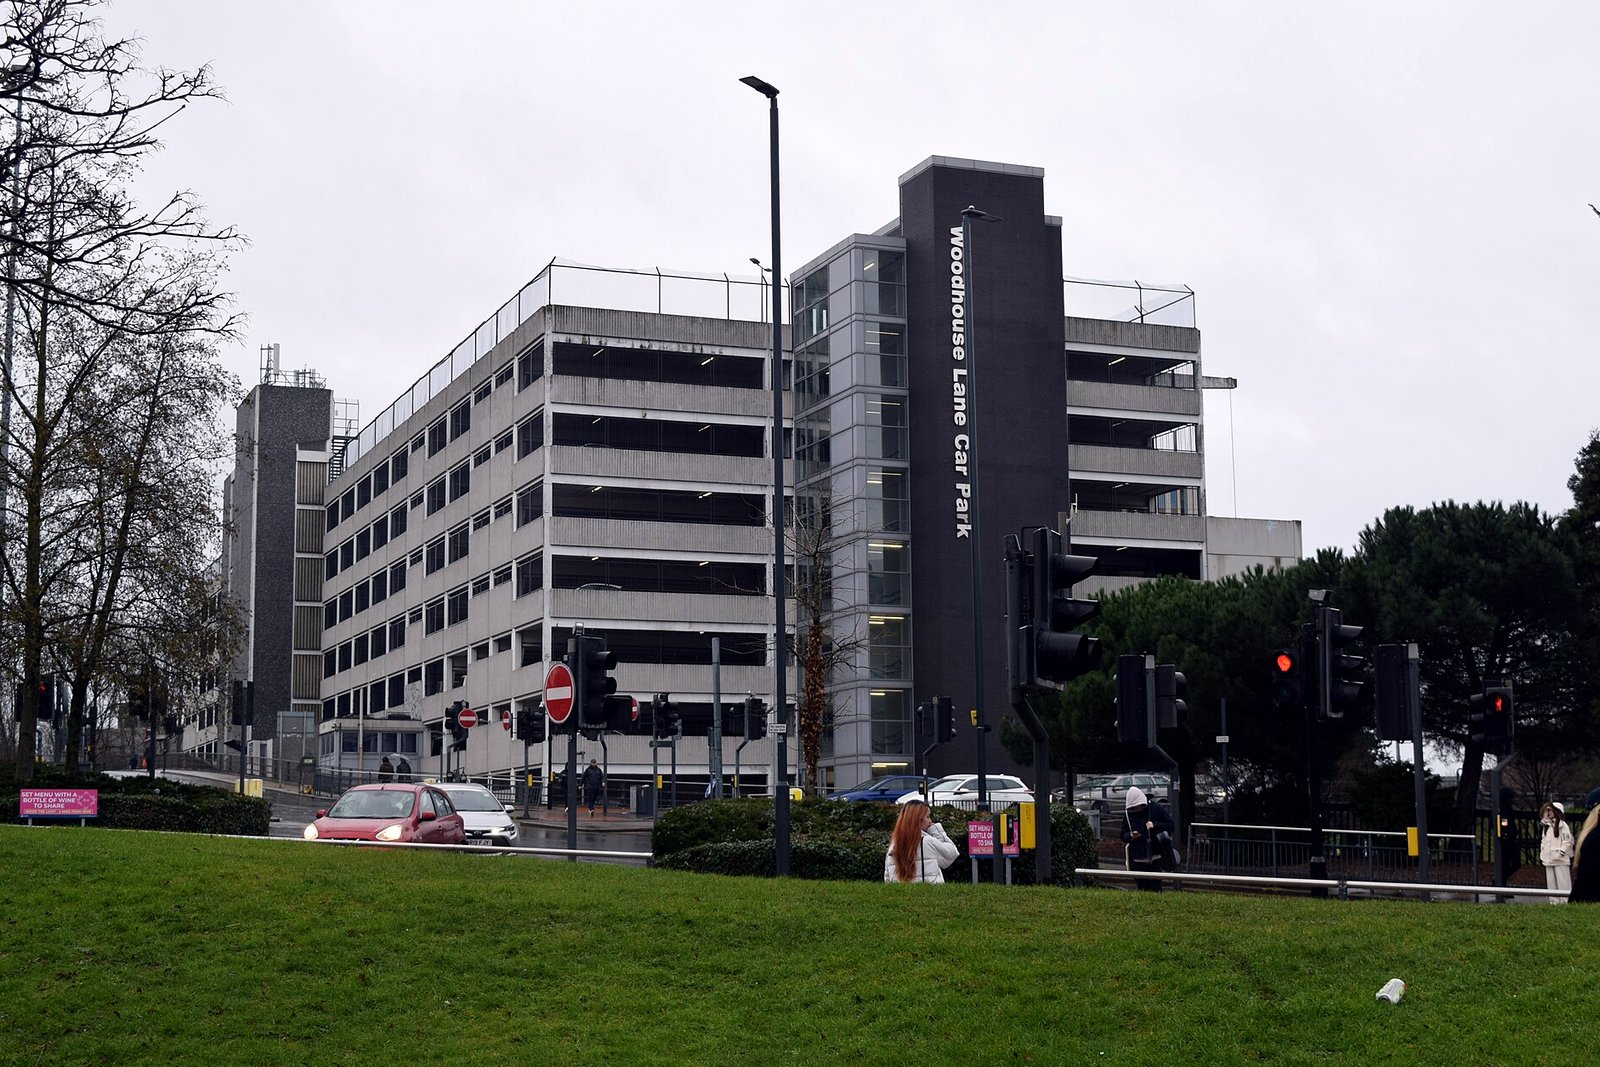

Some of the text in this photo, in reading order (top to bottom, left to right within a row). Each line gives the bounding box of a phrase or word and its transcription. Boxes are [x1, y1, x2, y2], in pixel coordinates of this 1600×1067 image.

[950, 226, 972, 539] Woodhouse Lane Car Park
